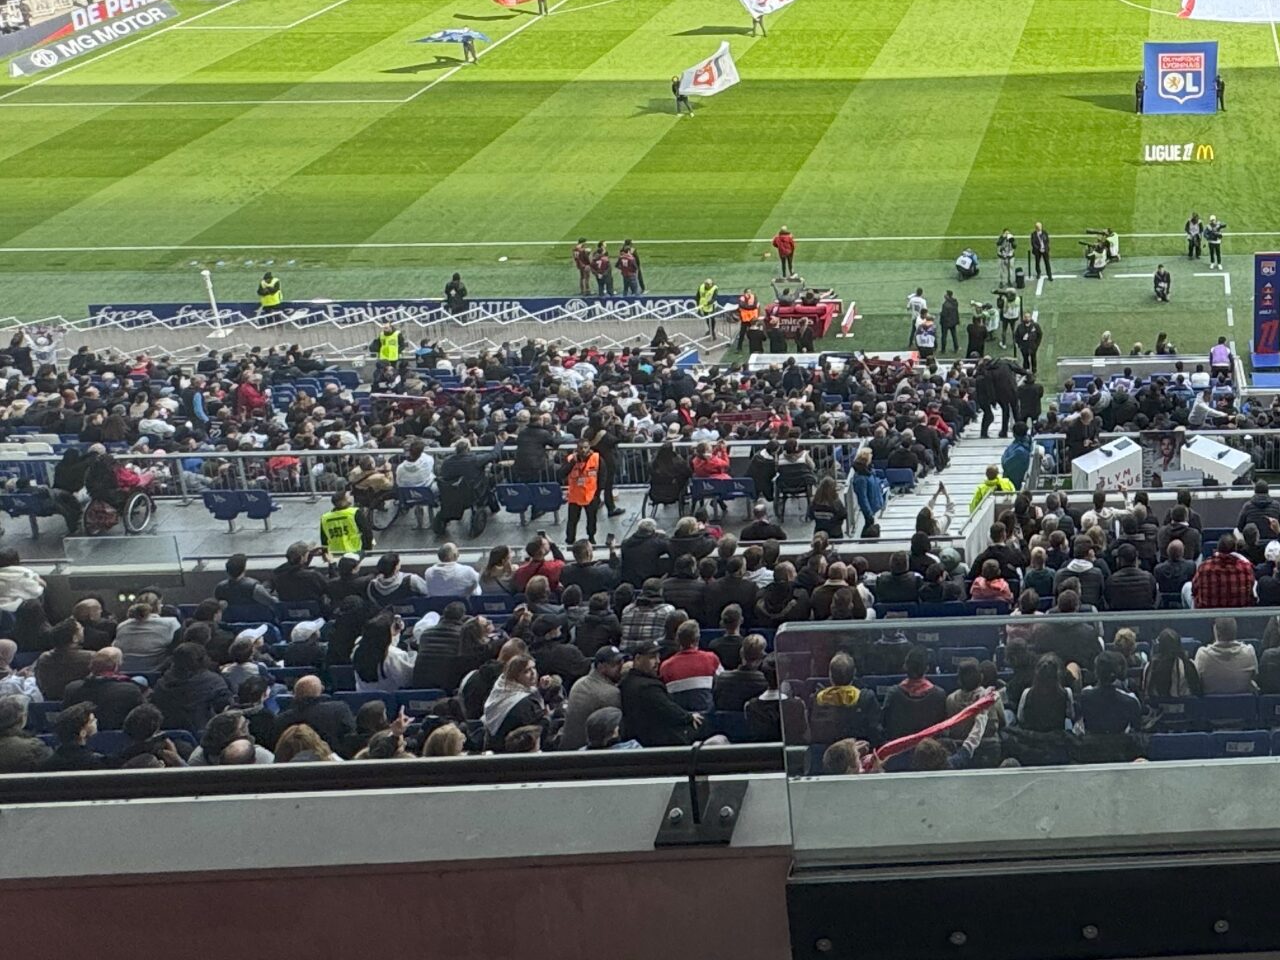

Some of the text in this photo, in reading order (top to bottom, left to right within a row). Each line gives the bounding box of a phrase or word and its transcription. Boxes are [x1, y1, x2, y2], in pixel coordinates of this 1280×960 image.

[71, 3, 102, 31] DE
[56, 34, 98, 58] MG
[92, 6, 168, 43] MOTOR
[1145, 145, 1182, 161] LIGUE
[95, 305, 154, 325] free
[327, 303, 431, 325] Emirates
[469, 300, 523, 321] BETTER
